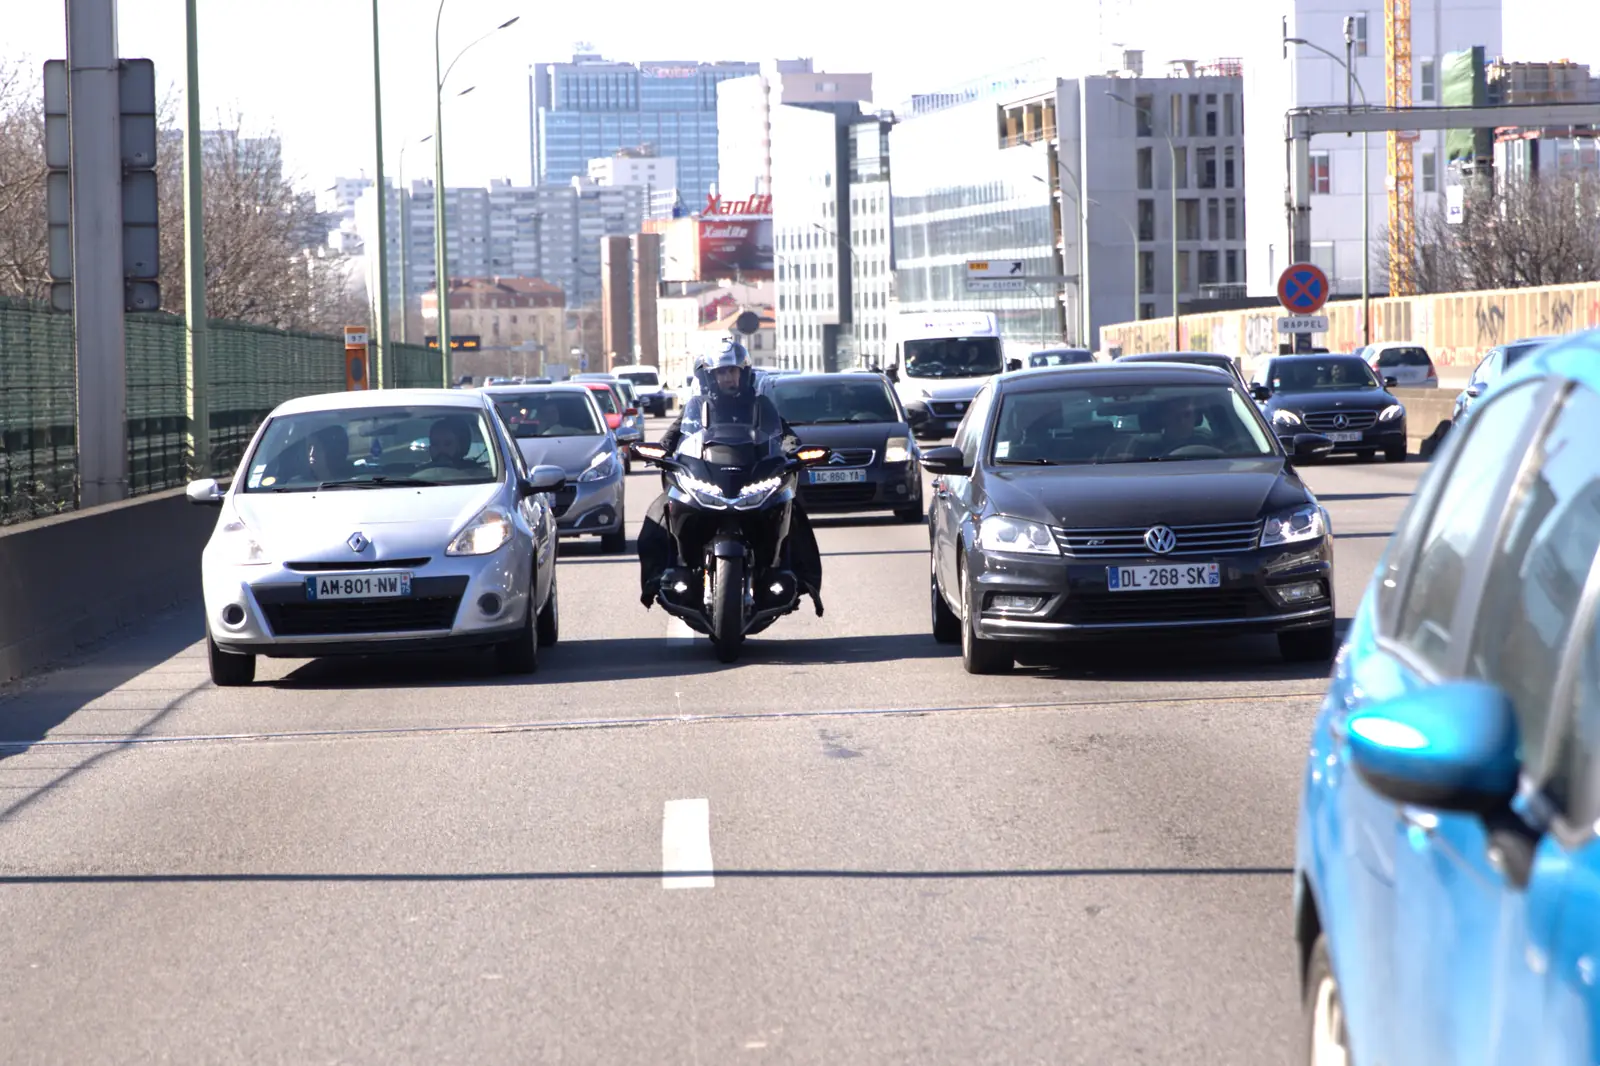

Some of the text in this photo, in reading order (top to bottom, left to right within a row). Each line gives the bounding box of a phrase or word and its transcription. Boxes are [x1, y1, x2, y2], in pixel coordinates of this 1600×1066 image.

[702, 193, 773, 215] XanLit
[704, 223, 748, 238] XanLite
[993, 281, 1022, 289] CLICHY
[1283, 320, 1324, 329] RAPPEL
[1121, 566, 1206, 588] DL-268-SK
[320, 577, 398, 596] AM-801-NW
